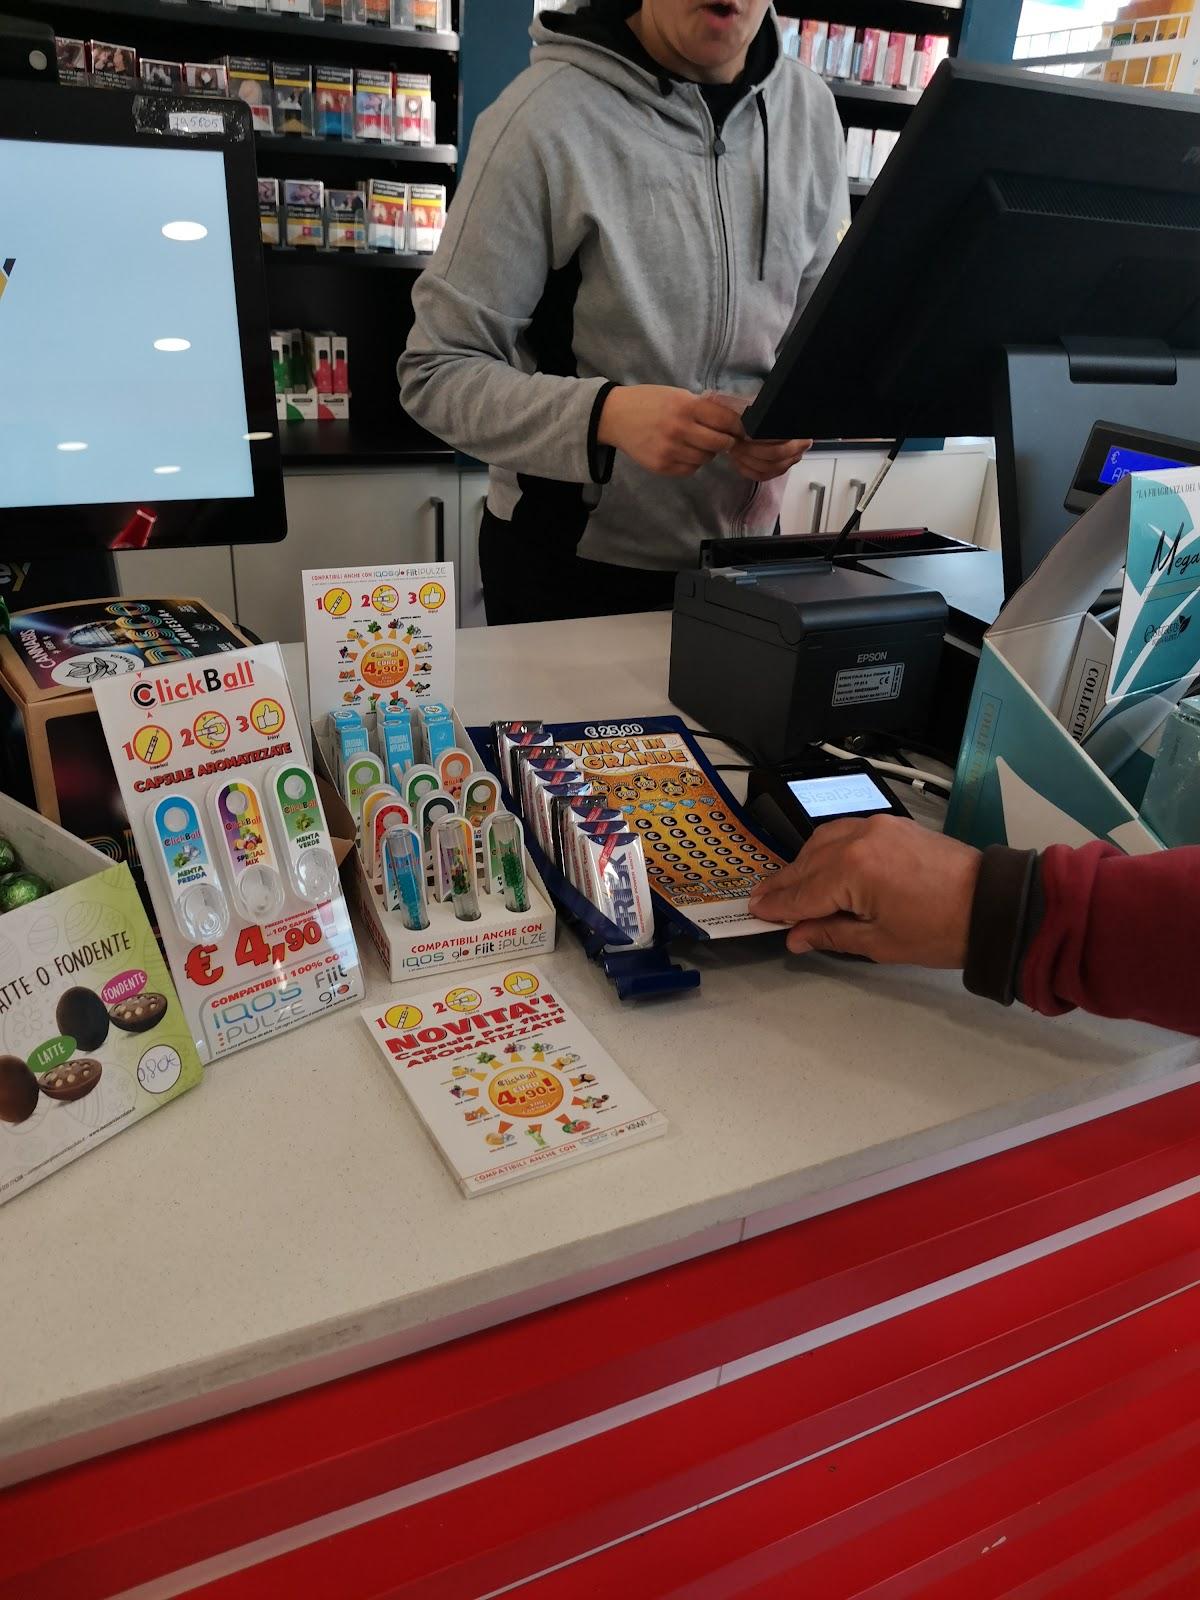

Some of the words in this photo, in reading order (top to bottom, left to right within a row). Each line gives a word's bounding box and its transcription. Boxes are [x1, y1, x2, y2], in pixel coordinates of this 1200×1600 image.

[316, 597, 323, 610] 1
[361, 594, 371, 608] 2
[408, 592, 417, 605] 3
[105, 602, 194, 666] DISCO
[160, 611, 198, 644] AMNESIA
[20, 629, 56, 669] CANNABIS
[857, 651, 888, 663] EPSON
[132, 660, 255, 708] ClickBall
[122, 742, 135, 760] 1
[180, 729, 194, 747] 2
[236, 716, 249, 733] 3
[564, 738, 639, 757] VINCI
[642, 738, 666, 749] IN
[598, 724, 644, 738] 25,00
[133, 768, 195, 793] CAPSULE
[197, 742, 292, 777] AROMATIZZATE
[583, 749, 688, 770] GRANDE
[237, 850, 266, 863] SPECIAL
[296, 832, 320, 844] MENTA
[299, 839, 321, 850] VERDE
[177, 865, 204, 878] MENTA
[245, 858, 260, 868] MIX
[606, 852, 639, 937] FRISK
[36, 966, 50, 986] O
[54, 931, 131, 977] FONDENTE
[184, 944, 224, 986] €
[234, 921, 322, 967] 4,90
[402, 952, 444, 969] IQOS
[501, 931, 547, 950] PULZE
[411, 936, 479, 954] COMPATIBILI
[482, 927, 517, 941] ANCHE
[521, 923, 543, 936] CON
[102, 971, 147, 1001] FONDENTE
[211, 974, 288, 1009] COMPATIBILI
[291, 959, 323, 978] 100%
[324, 950, 349, 965] CON
[213, 981, 303, 1030] IQOS
[226, 1000, 307, 1044] PULZE
[375, 1017, 387, 1030] 1
[432, 1001, 448, 1015] 2
[490, 986, 504, 998] 3
[385, 994, 560, 1054] NOVITA'!
[37, 1042, 66, 1066] LATTE
[394, 1035, 475, 1062] Capsule
[482, 1023, 514, 1039] per
[520, 1008, 565, 1026] filtri
[406, 1016, 567, 1068] AROMATIZZATE
[474, 1161, 527, 1183] COMPATIBILI
[529, 1151, 557, 1164] ANCHE
[558, 1143, 578, 1154] CON
